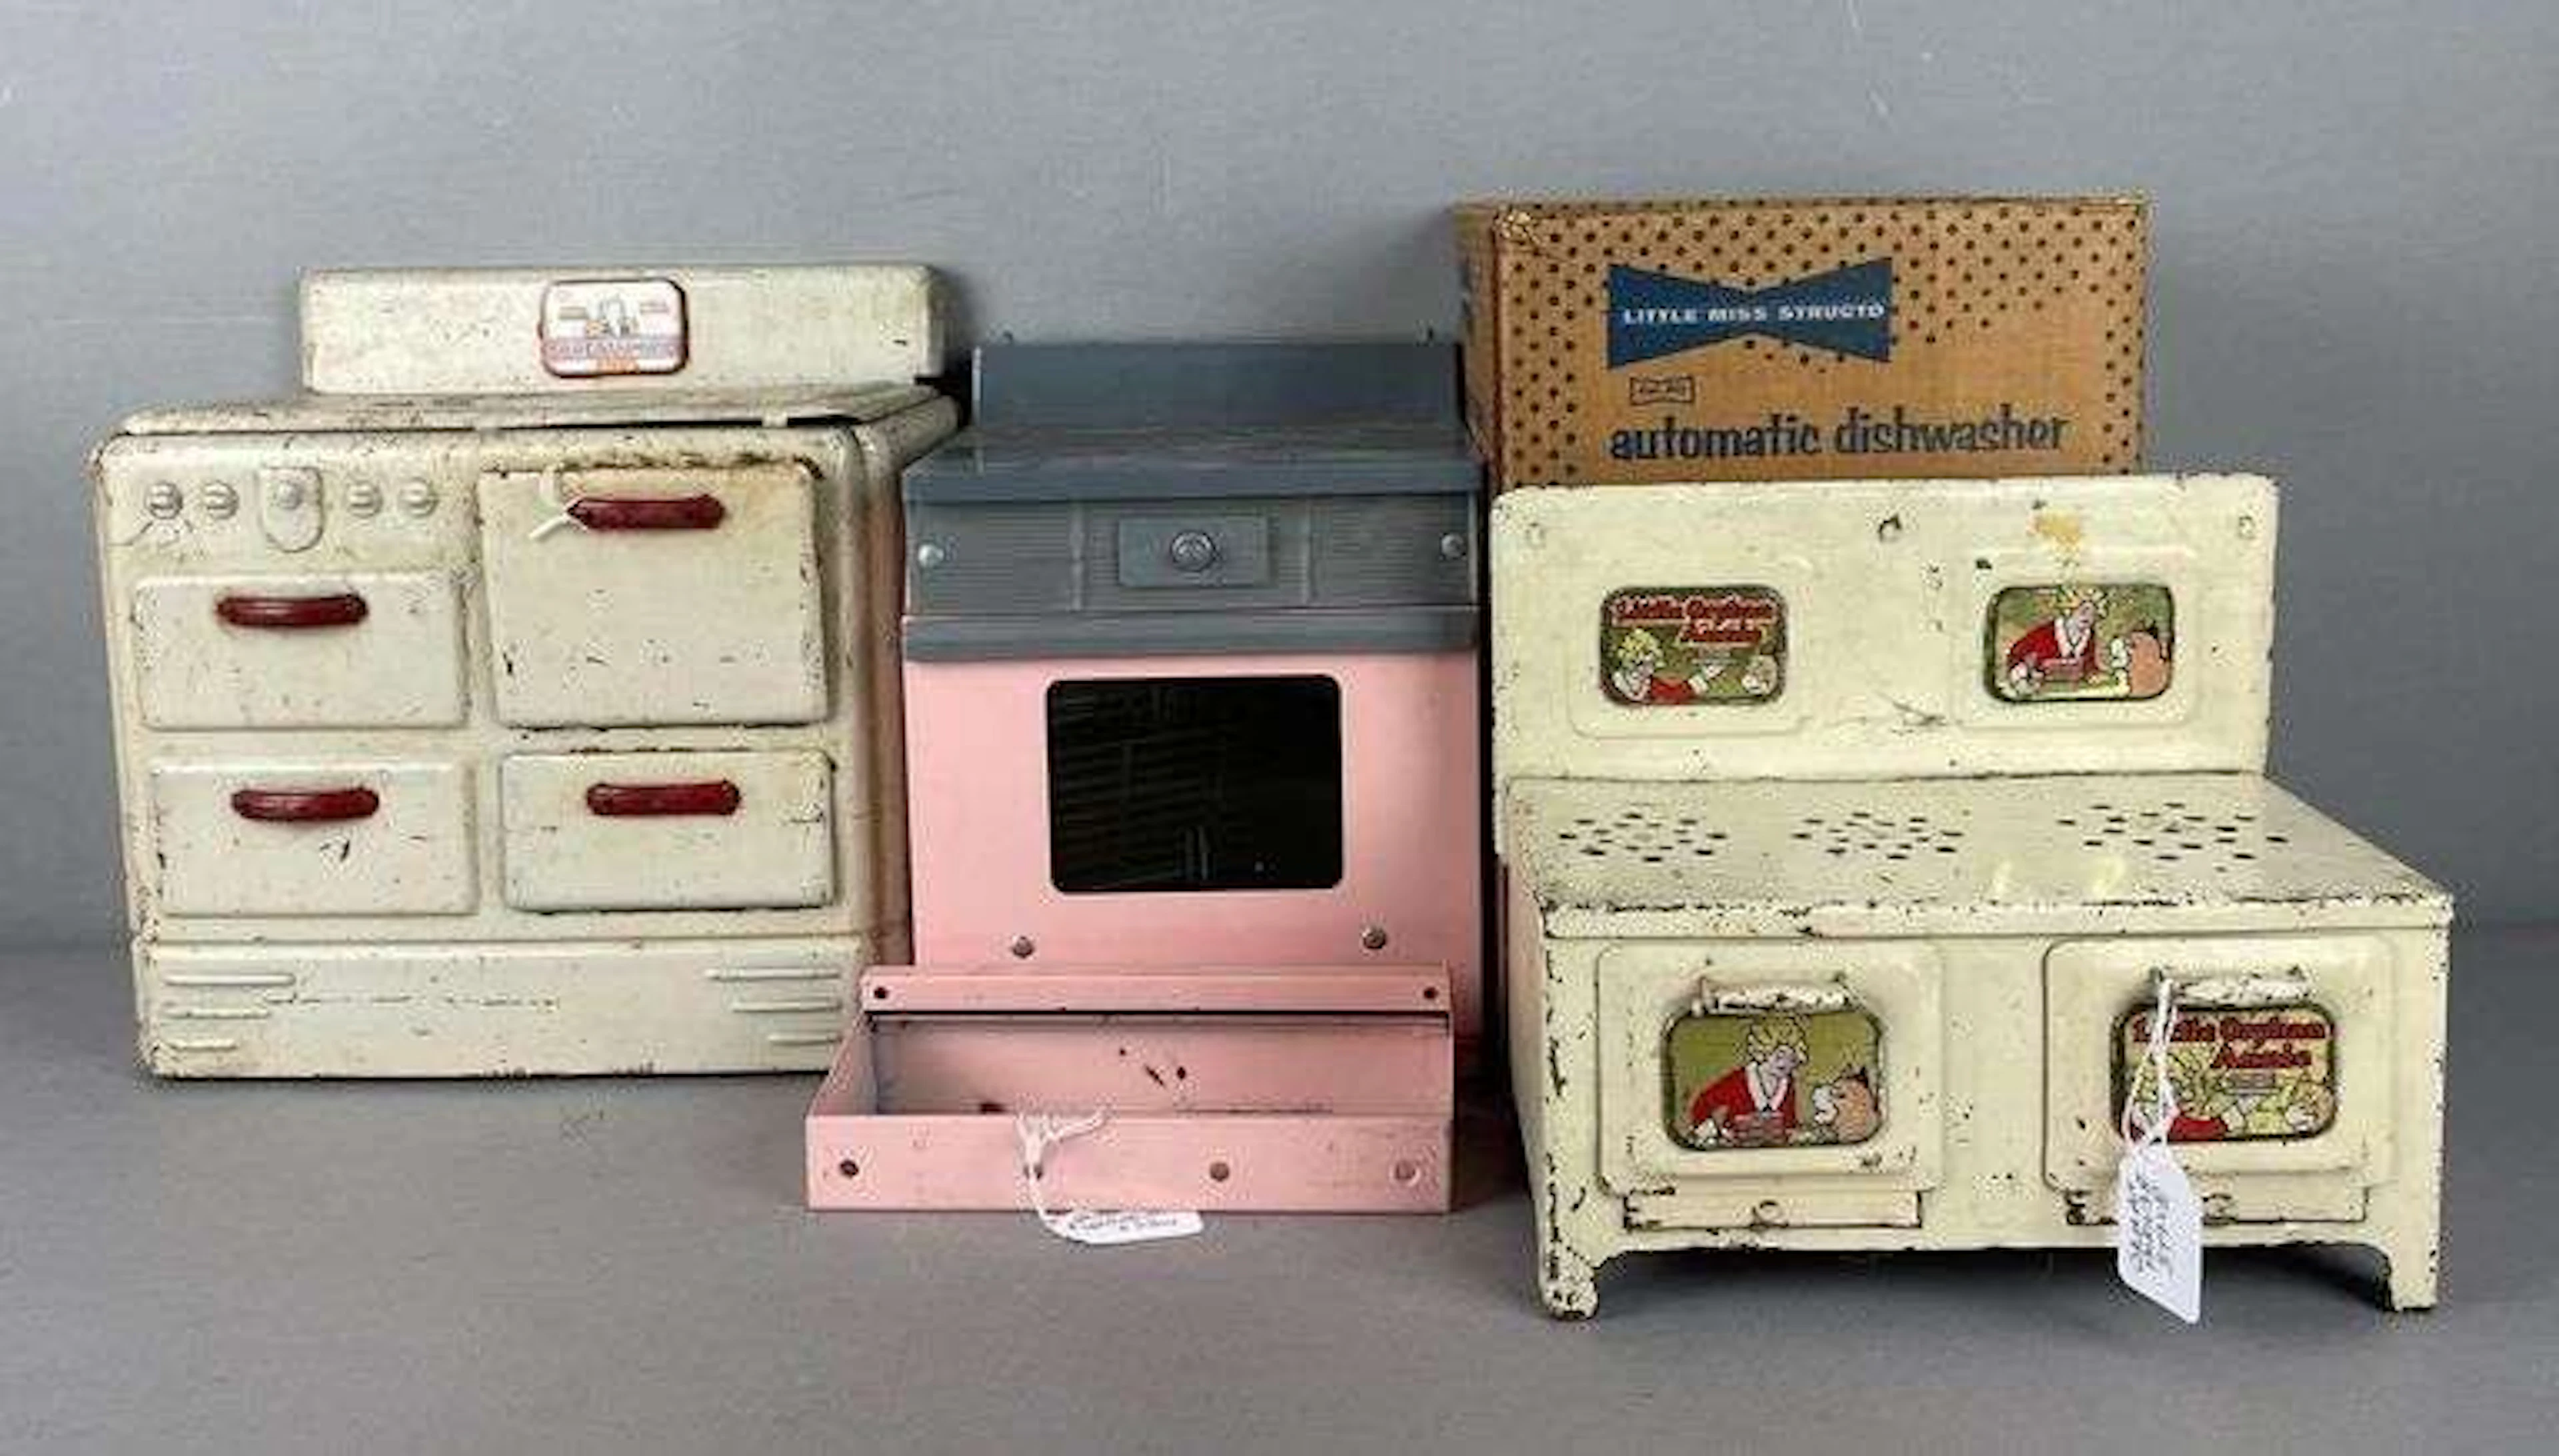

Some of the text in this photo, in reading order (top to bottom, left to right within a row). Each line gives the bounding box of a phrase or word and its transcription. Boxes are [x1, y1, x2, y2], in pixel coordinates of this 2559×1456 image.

[1624, 302, 1885, 325] LITTLE MISS STRUCTO
[1609, 401, 2070, 460] automatic dishwasher
